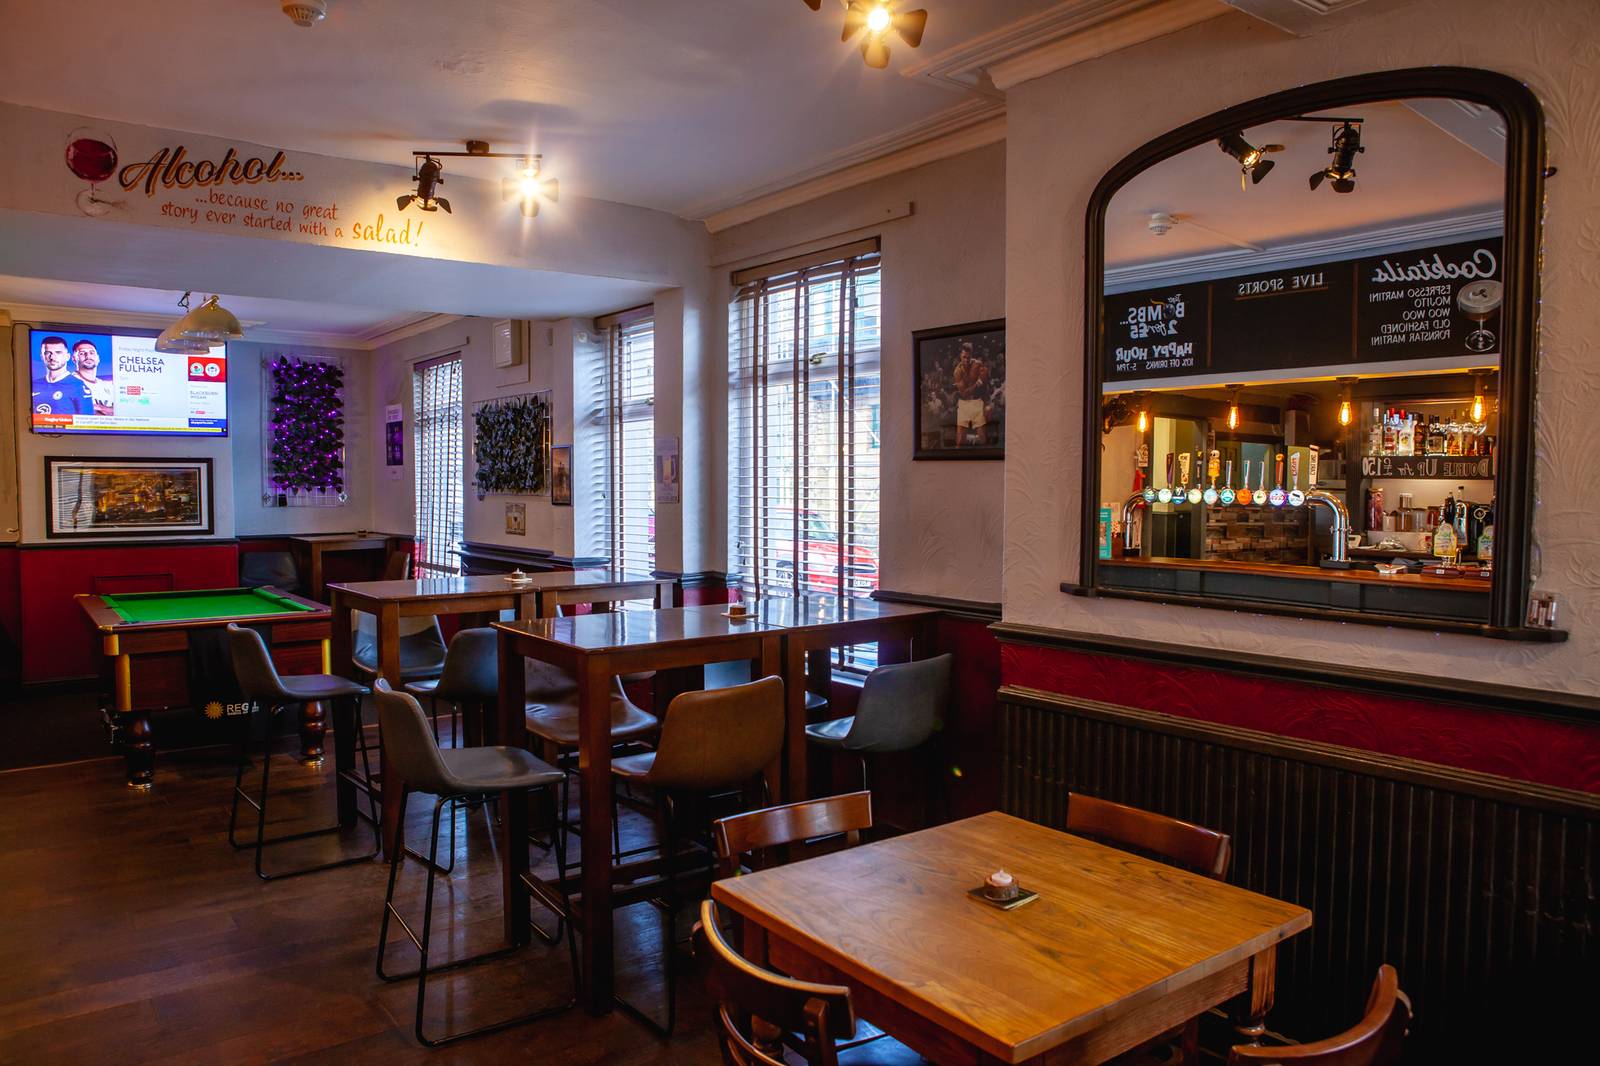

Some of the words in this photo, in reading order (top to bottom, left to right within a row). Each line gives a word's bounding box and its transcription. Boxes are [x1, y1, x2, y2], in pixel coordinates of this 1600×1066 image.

[118, 146, 304, 197] Alcohol...
[196, 189, 269, 211] ...because
[276, 200, 294, 213] no
[303, 202, 338, 220] great
[161, 201, 198, 224] story
[206, 209, 236, 224] ever
[243, 213, 293, 232] started
[299, 222, 328, 237] with
[335, 227, 344, 238] a
[353, 213, 423, 247] salad!
[119, 355, 165, 366] CHELSEA
[119, 364, 162, 374] FULHAM
